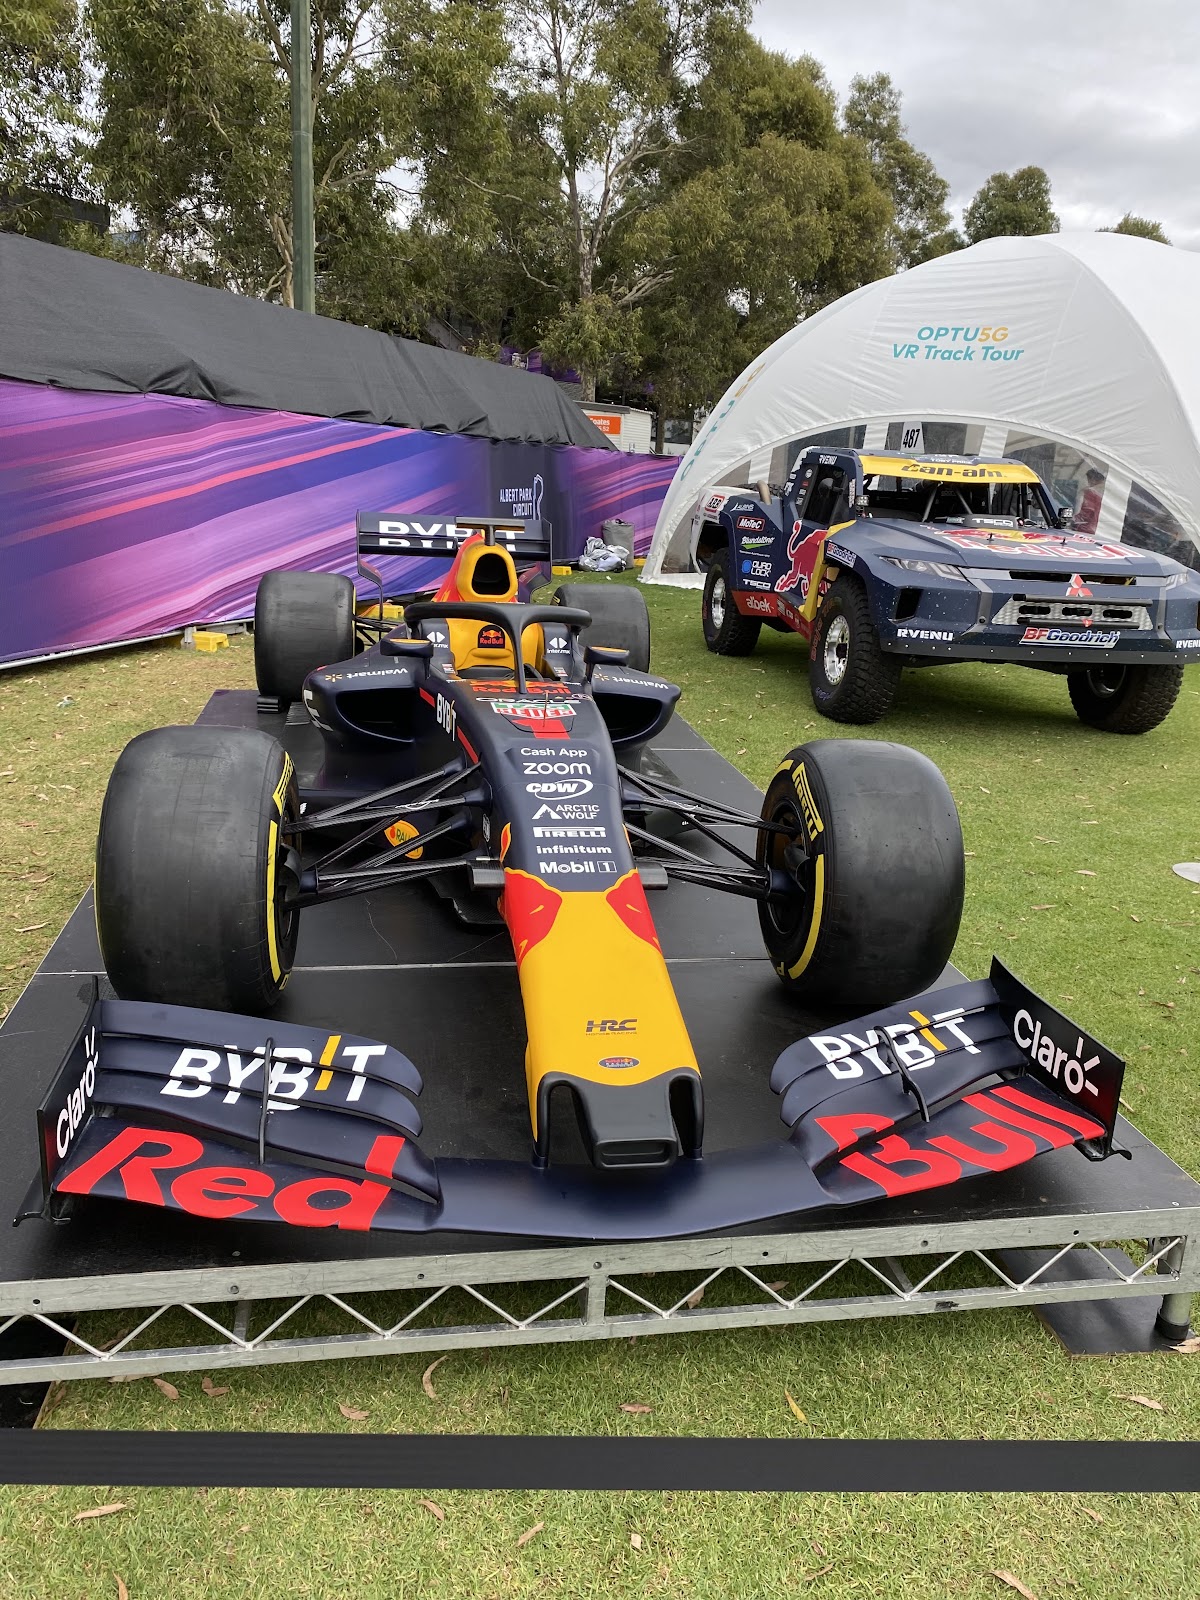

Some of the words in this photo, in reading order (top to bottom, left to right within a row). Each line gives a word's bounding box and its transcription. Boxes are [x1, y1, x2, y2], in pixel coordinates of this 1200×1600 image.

[917, 326, 1009, 343] OPTU5G
[893, 344, 918, 359] VR
[924, 344, 978, 361] Track
[981, 345, 1024, 362] Tour
[902, 428, 921, 449] 487
[500, 488, 518, 503] ALBERT
[519, 488, 533, 502] PARK
[512, 502, 532, 517] CIRCUIT
[479, 637, 492, 645] Red
[491, 637, 504, 645] Bull
[897, 628, 954, 641] RVENU
[1023, 627, 1119, 645] BFGoodrich
[346, 667, 409, 679] Walmart
[611, 675, 669, 690] Walmart
[436, 692, 457, 742] BYBIT
[520, 747, 555, 756] Cash
[559, 748, 588, 758] App
[526, 782, 579, 793] CDW
[555, 804, 600, 812] ARCTIC
[791, 762, 825, 842] PIRELLI
[563, 812, 598, 820] WOLF
[533, 826, 607, 838] PIRELLI
[536, 845, 613, 855] infinitum
[539, 861, 595, 874] Mobil
[586, 1018, 638, 1033] HRC
[808, 1008, 985, 1081] BYBIT
[1013, 1009, 1090, 1095] Claro
[159, 1034, 388, 1111] BYBIT
[56, 1040, 99, 1159] Claro
[56, 1126, 406, 1231] Red
[814, 1085, 1106, 1198] Bull
